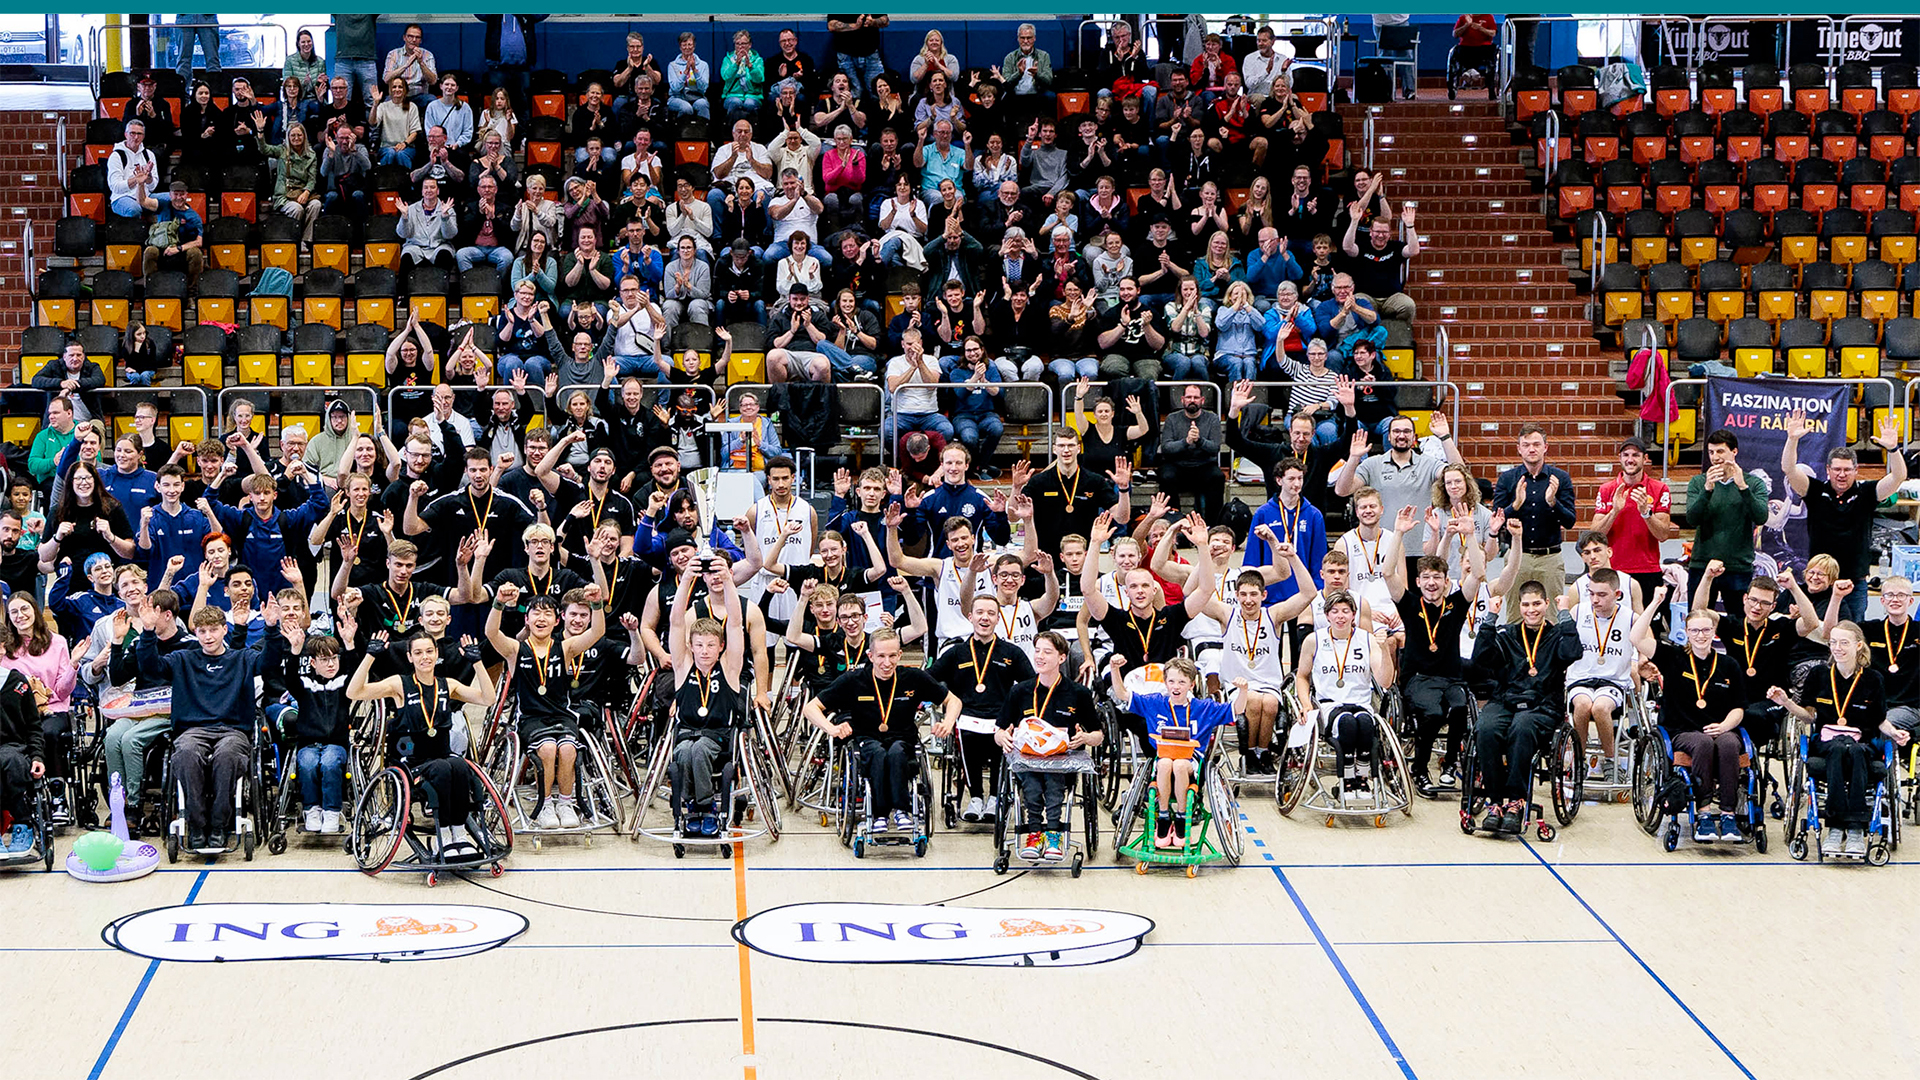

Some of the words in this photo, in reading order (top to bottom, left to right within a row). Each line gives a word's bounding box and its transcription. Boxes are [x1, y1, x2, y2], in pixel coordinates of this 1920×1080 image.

[1817, 24, 1903, 51] TimeOut
[1845, 50, 1871, 61] BBQ
[1722, 392, 1833, 413] FASZINATION
[1724, 413, 1758, 428] AUF
[1760, 414, 1828, 434] RÄRN
[550, 584, 561, 595] 13
[1477, 600, 1486, 611] 6
[1016, 614, 1031, 628] 10
[1258, 626, 1267, 639] 3
[1610, 629, 1622, 642] 8
[584, 648, 598, 658] 10
[1353, 648, 1363, 660] 5
[547, 663, 562, 678] 11
[710, 679, 720, 693] 8
[439, 697, 447, 711] 7
[165, 921, 344, 943] ING
[795, 922, 972, 943] ING
